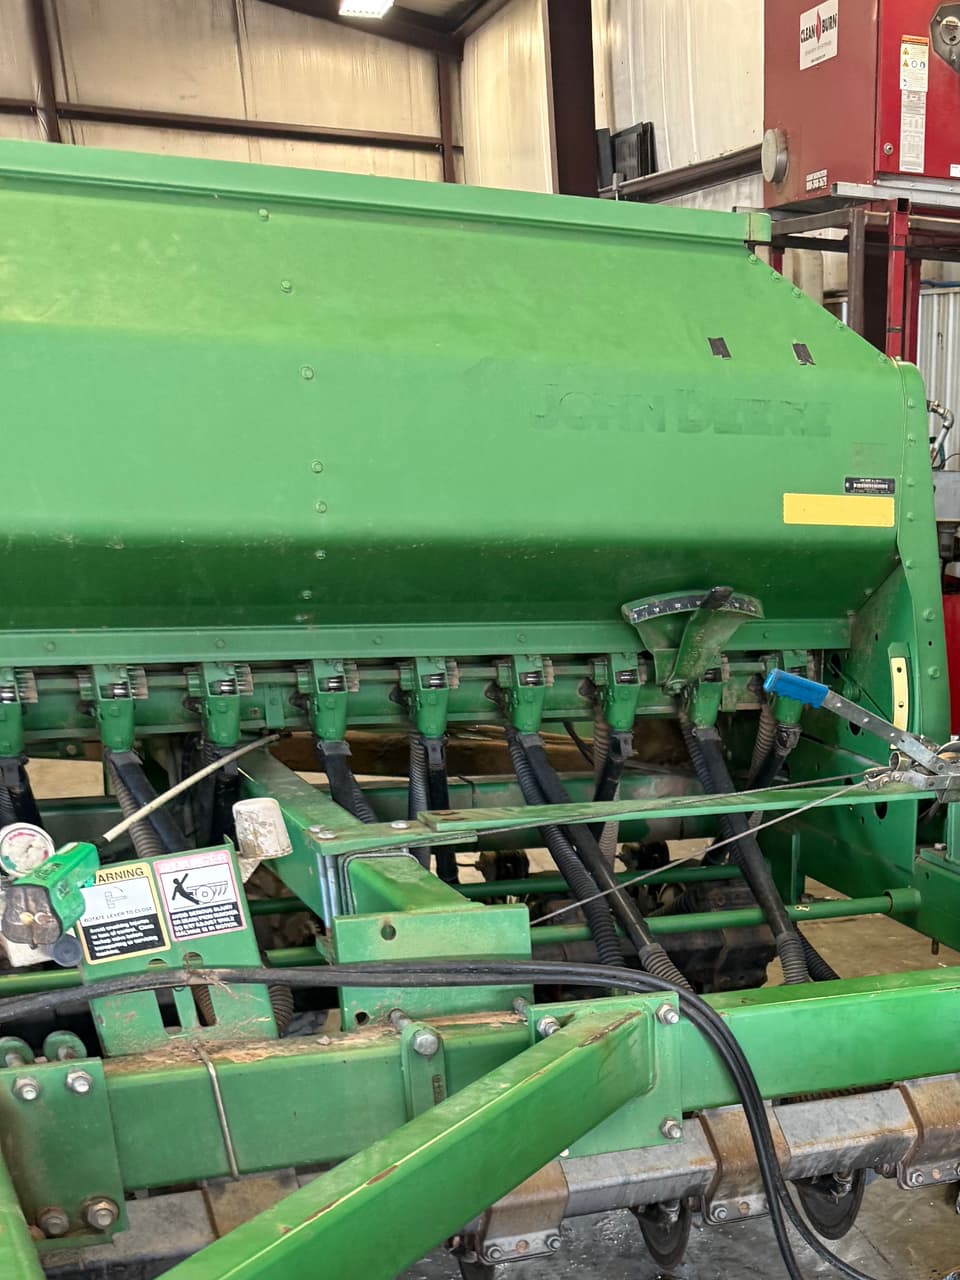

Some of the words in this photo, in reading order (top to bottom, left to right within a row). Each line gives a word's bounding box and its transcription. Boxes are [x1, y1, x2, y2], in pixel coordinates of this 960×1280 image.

[800, 23, 816, 44] CLEAN
[822, 13, 838, 34] BURN
[98, 867, 145, 884] ARNING
